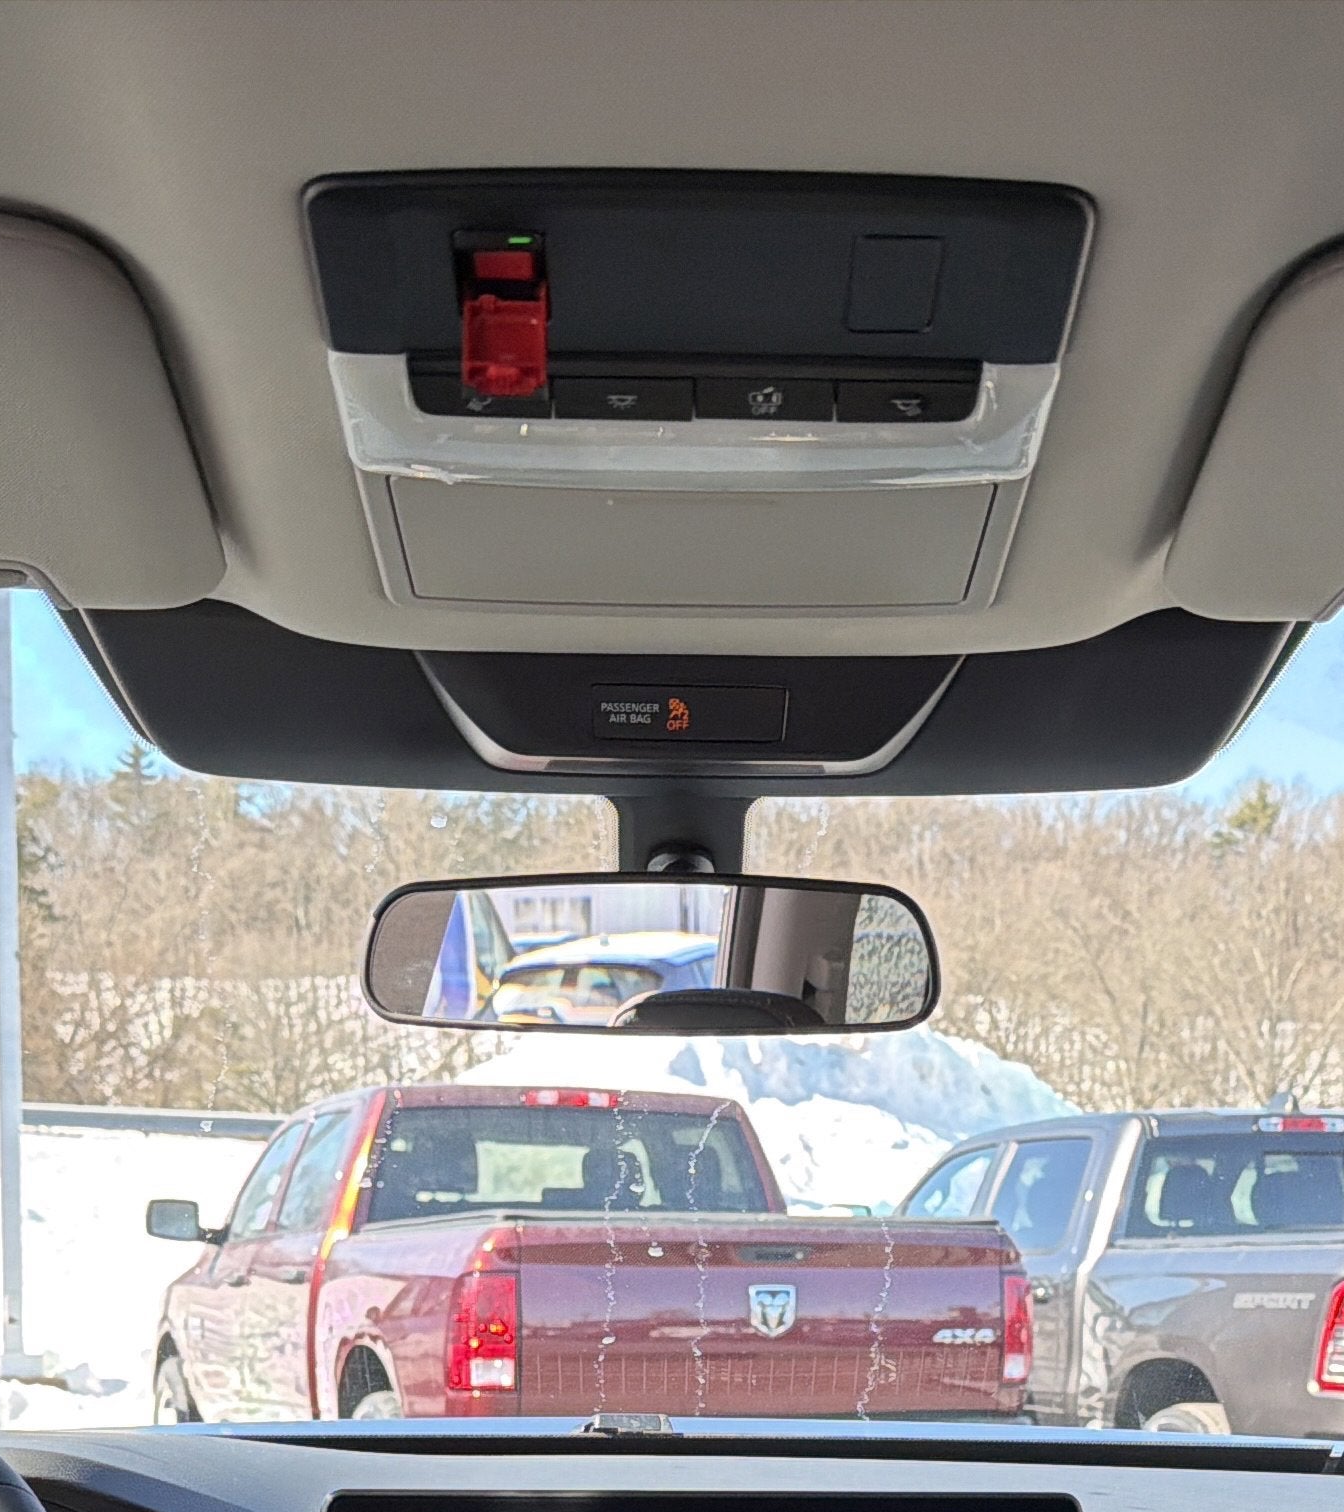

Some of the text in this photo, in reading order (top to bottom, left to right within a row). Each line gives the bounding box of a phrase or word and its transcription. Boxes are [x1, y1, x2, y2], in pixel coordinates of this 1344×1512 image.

[601, 702, 660, 713] PASSENGER
[609, 714, 652, 725] AIR BAG
[666, 720, 689, 731] OFF
